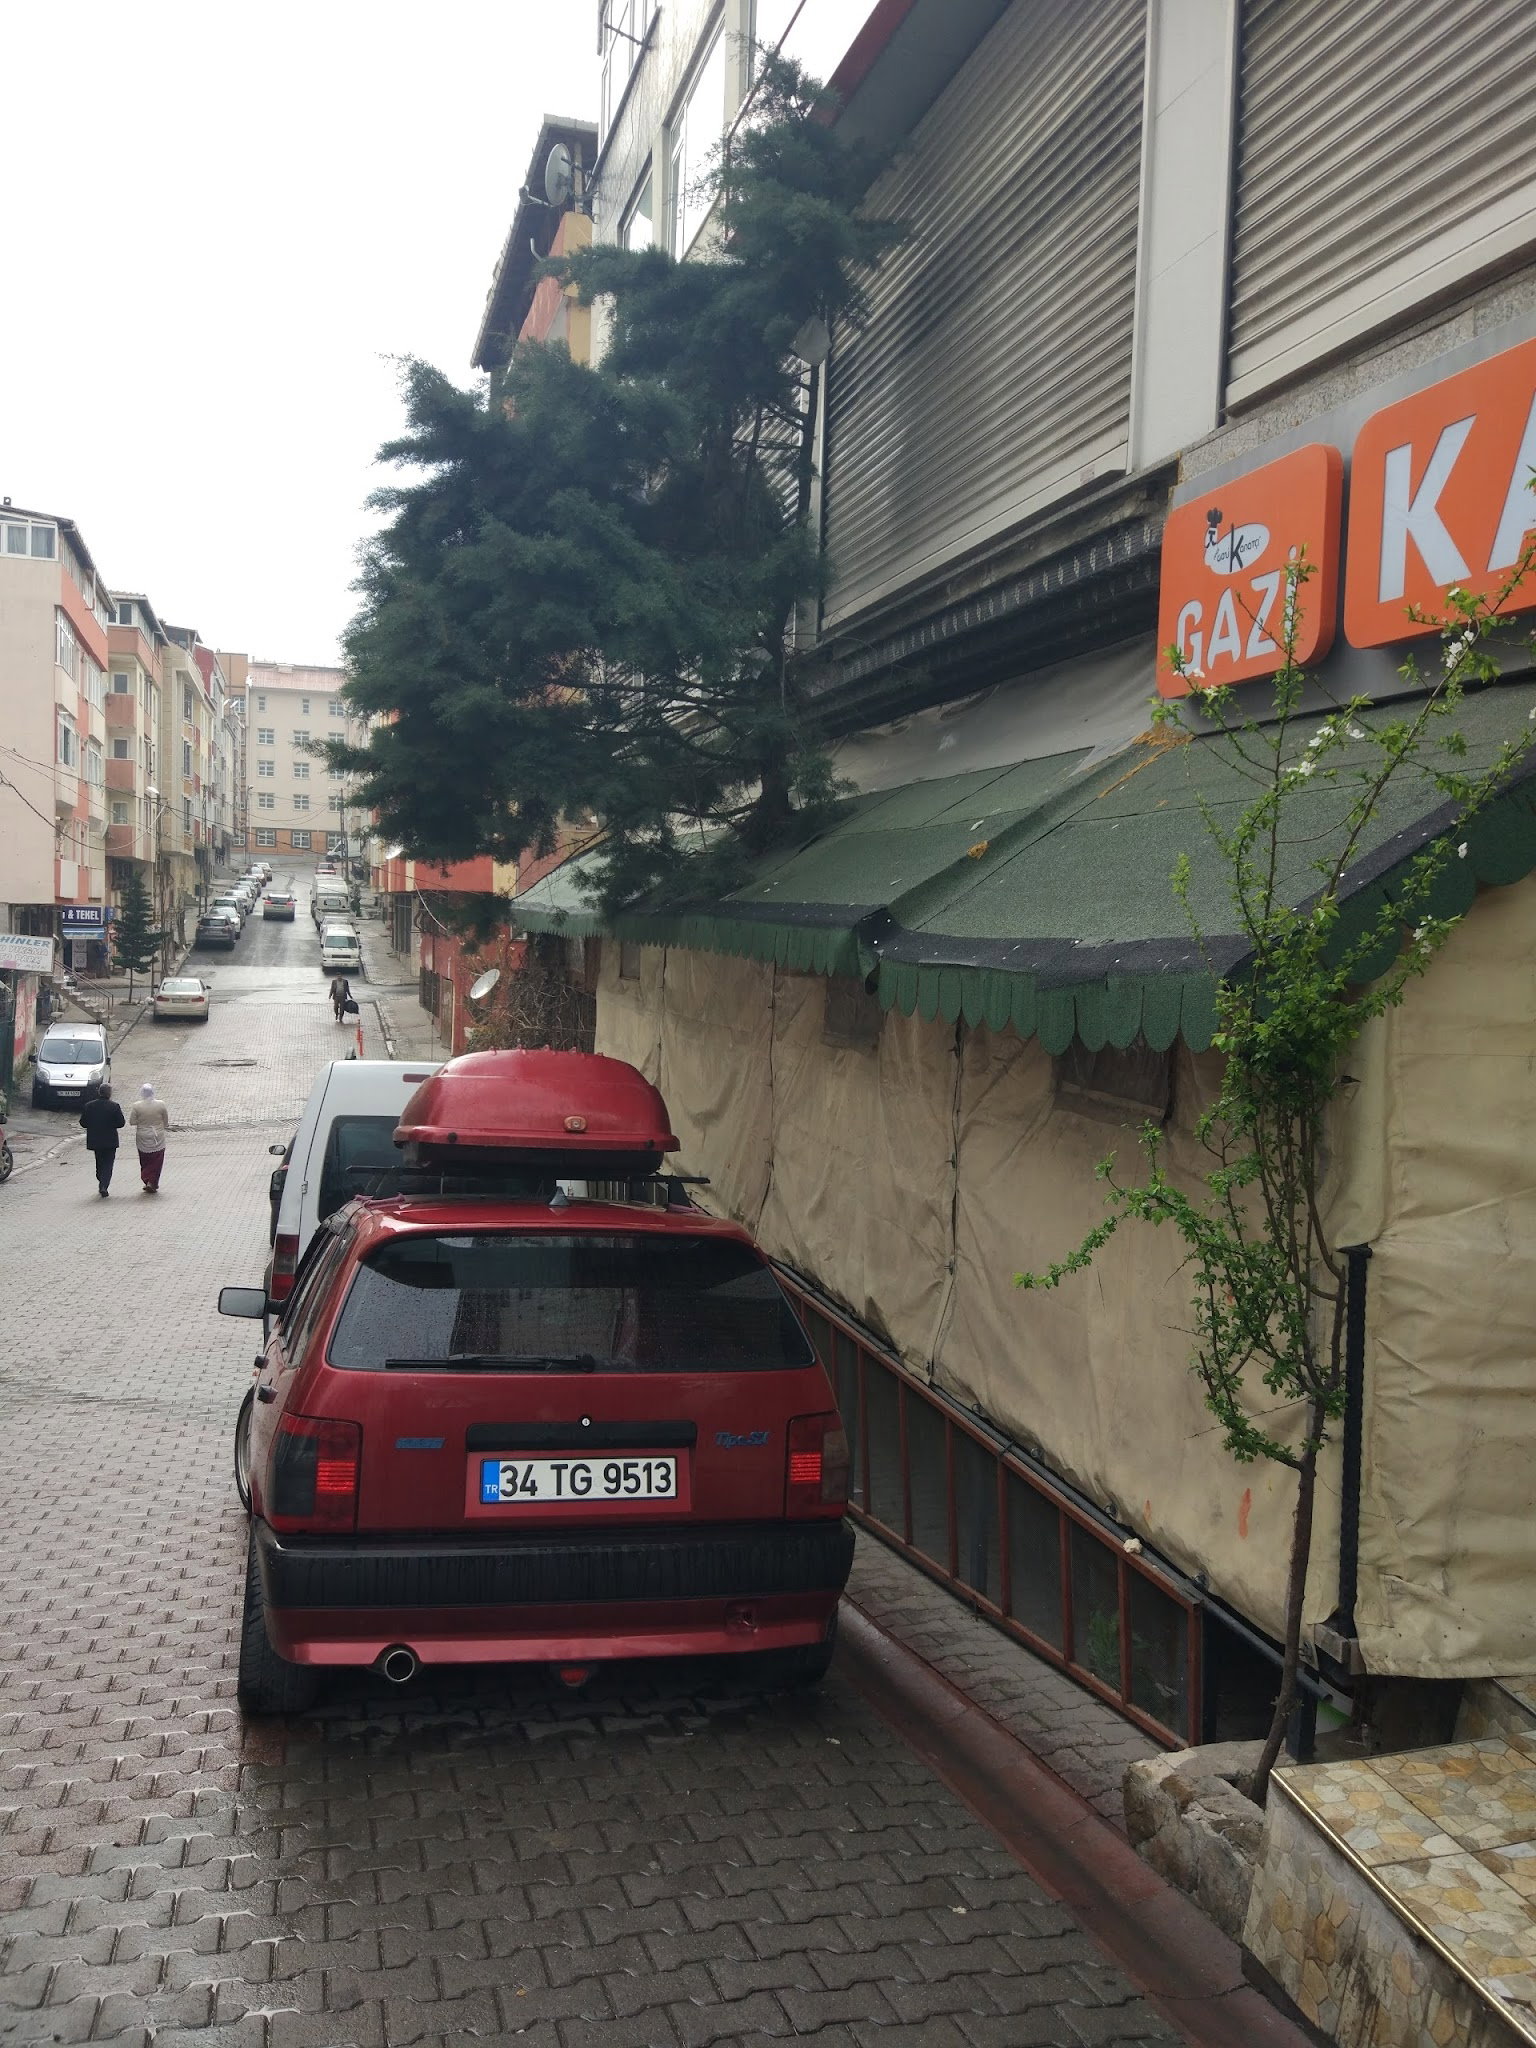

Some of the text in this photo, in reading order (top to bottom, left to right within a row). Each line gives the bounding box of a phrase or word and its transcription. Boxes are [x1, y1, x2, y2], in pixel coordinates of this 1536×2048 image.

[76, 909, 99, 920] TEKEL
[500, 1461, 672, 1498] 34 TG 9513
[484, 1484, 498, 1494] TR
